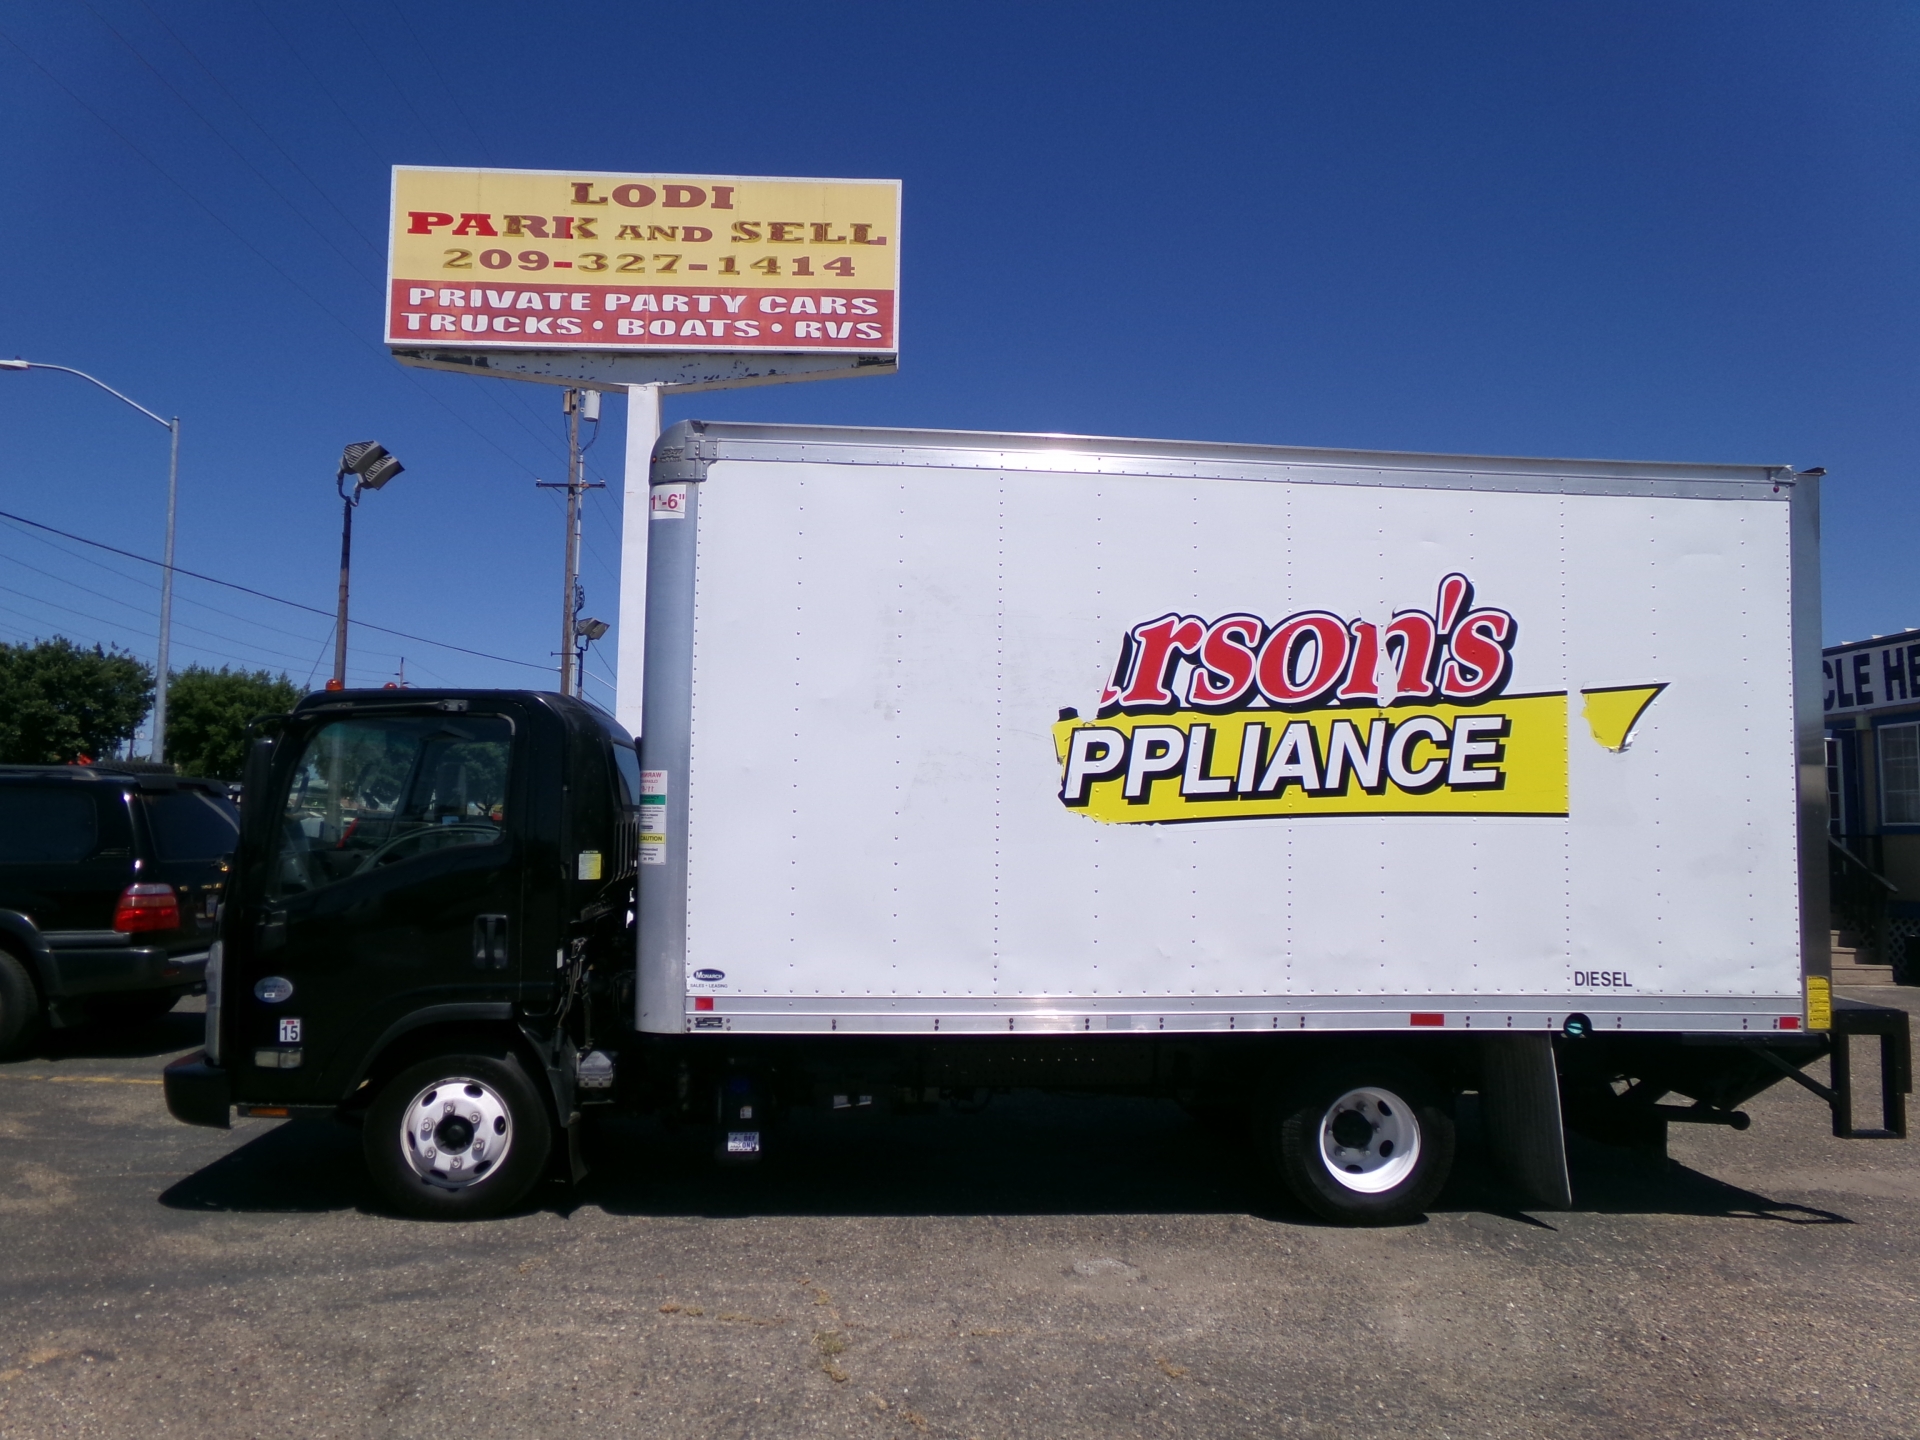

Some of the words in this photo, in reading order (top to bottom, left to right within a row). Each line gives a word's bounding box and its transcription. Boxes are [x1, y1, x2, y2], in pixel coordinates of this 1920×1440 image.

[570, 182, 734, 209] LODI
[407, 211, 598, 239] PARK
[615, 224, 713, 242] AND
[730, 220, 887, 245] SELL
[442, 248, 855, 277] 209-327-1414
[409, 288, 591, 311] PRIVATE
[604, 293, 748, 314] PARTY
[759, 296, 879, 315] CARS
[400, 313, 582, 334] TRUCKS
[617, 318, 760, 337] BOATS
[795, 321, 883, 339] RVS
[1100, 572, 1517, 707] rson's
[1060, 715, 1511, 804] PPLIANCE
[1574, 971, 1632, 987] DIESEL
[281, 1025, 299, 1041] 15
